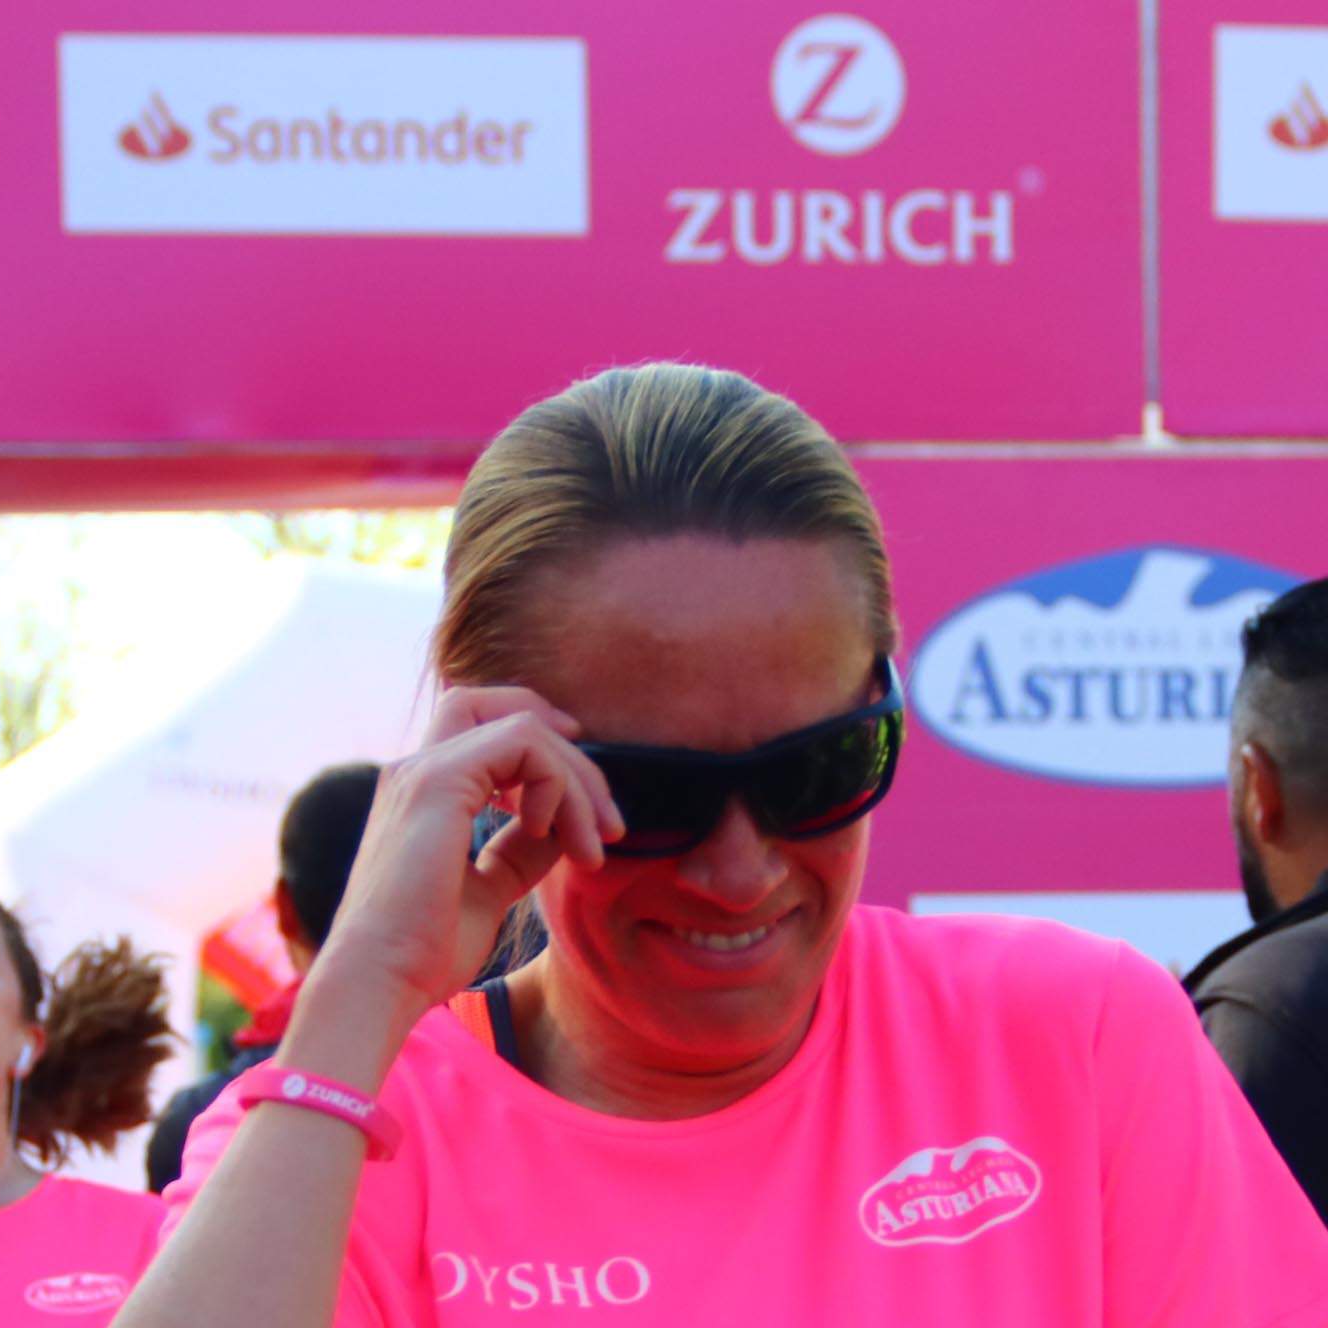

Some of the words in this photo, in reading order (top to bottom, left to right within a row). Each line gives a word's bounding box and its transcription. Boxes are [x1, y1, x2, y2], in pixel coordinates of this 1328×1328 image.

[208, 104, 534, 168] Santander
[664, 190, 1014, 266] ZURICH
[949, 638, 1232, 724] ASTURI
[308, 1082, 370, 1118] ZURICH
